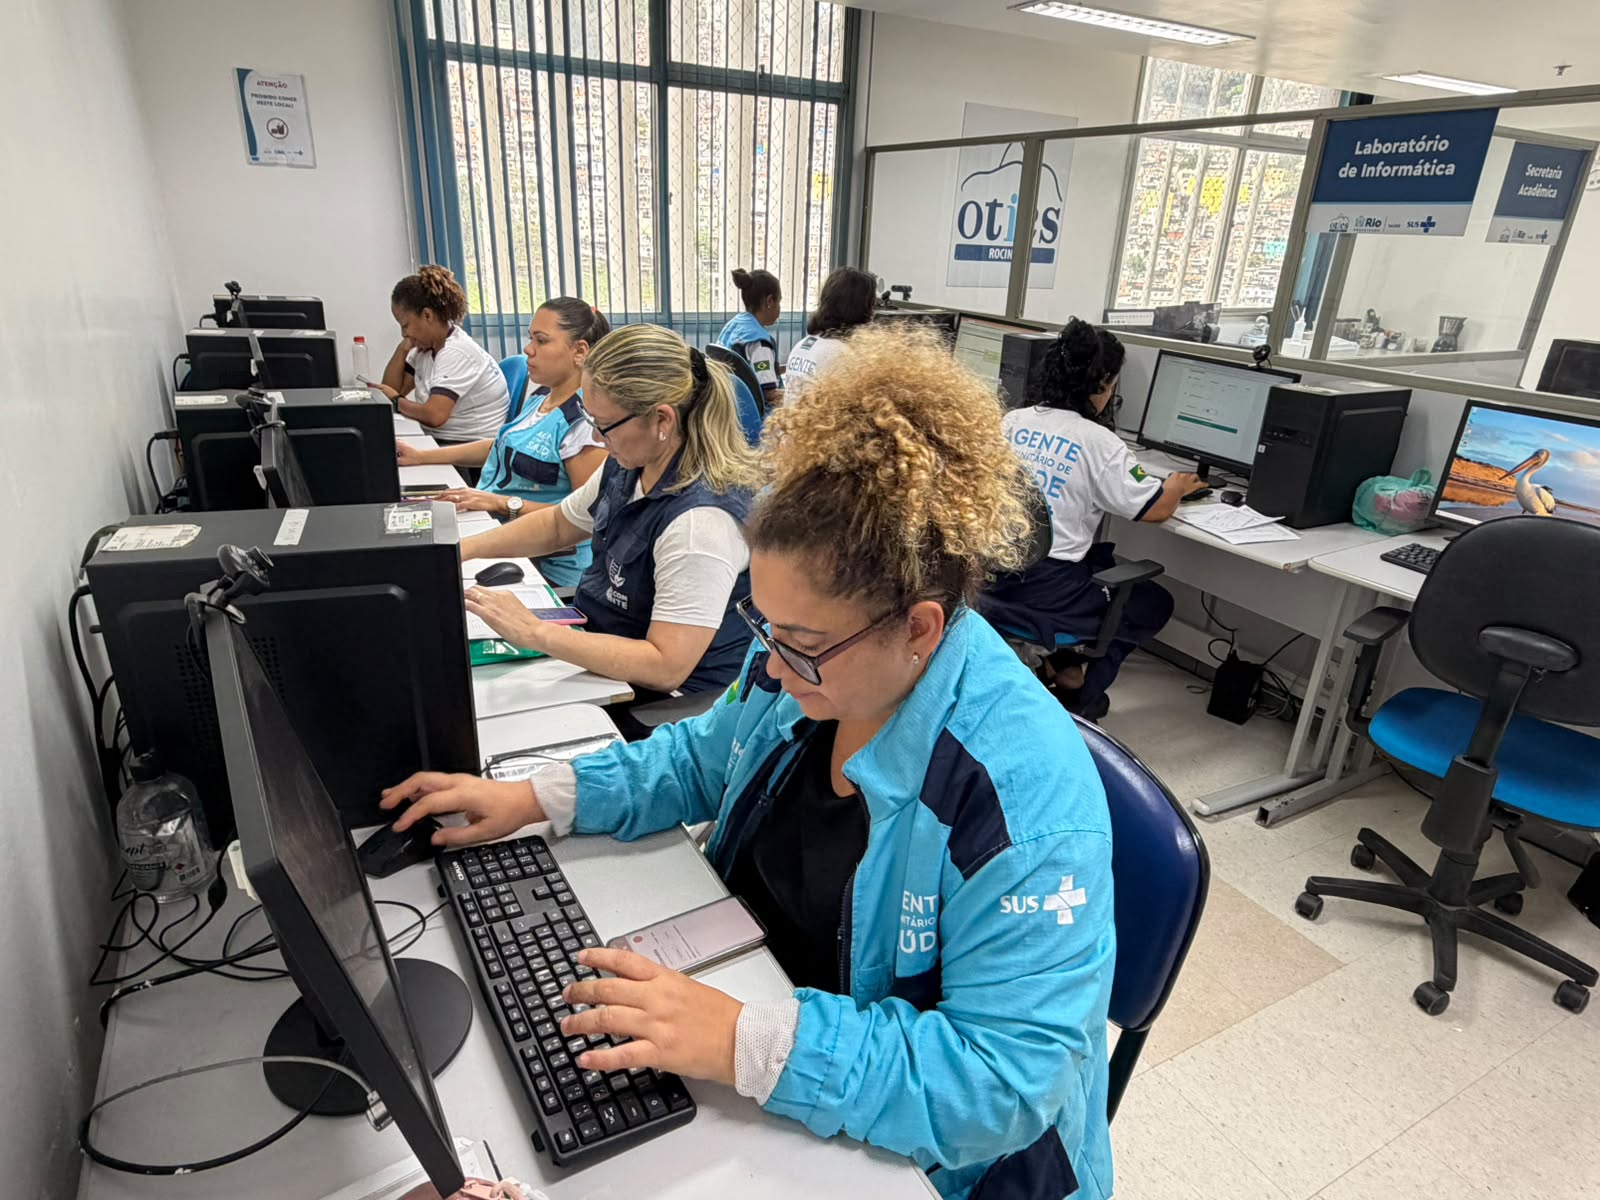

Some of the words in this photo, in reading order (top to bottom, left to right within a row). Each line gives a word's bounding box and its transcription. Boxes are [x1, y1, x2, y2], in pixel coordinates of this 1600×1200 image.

[256, 80, 288, 89] ATENÇÃO
[1354, 134, 1450, 155] Laboratório
[1338, 161, 1358, 178] de
[1360, 158, 1456, 178] Informática
[1524, 163, 1563, 179] Secretaria
[1517, 182, 1558, 198] Acadêmica
[957, 193, 1061, 244] otis
[1364, 217, 1382, 228] Rio
[988, 247, 1013, 260] ROCIN
[788, 356, 817, 377] GENTE
[1056, 462, 1073, 475] DE
[902, 890, 938, 914] ENT
[1000, 894, 1040, 915] SUS
[900, 930, 937, 954] ÚD
